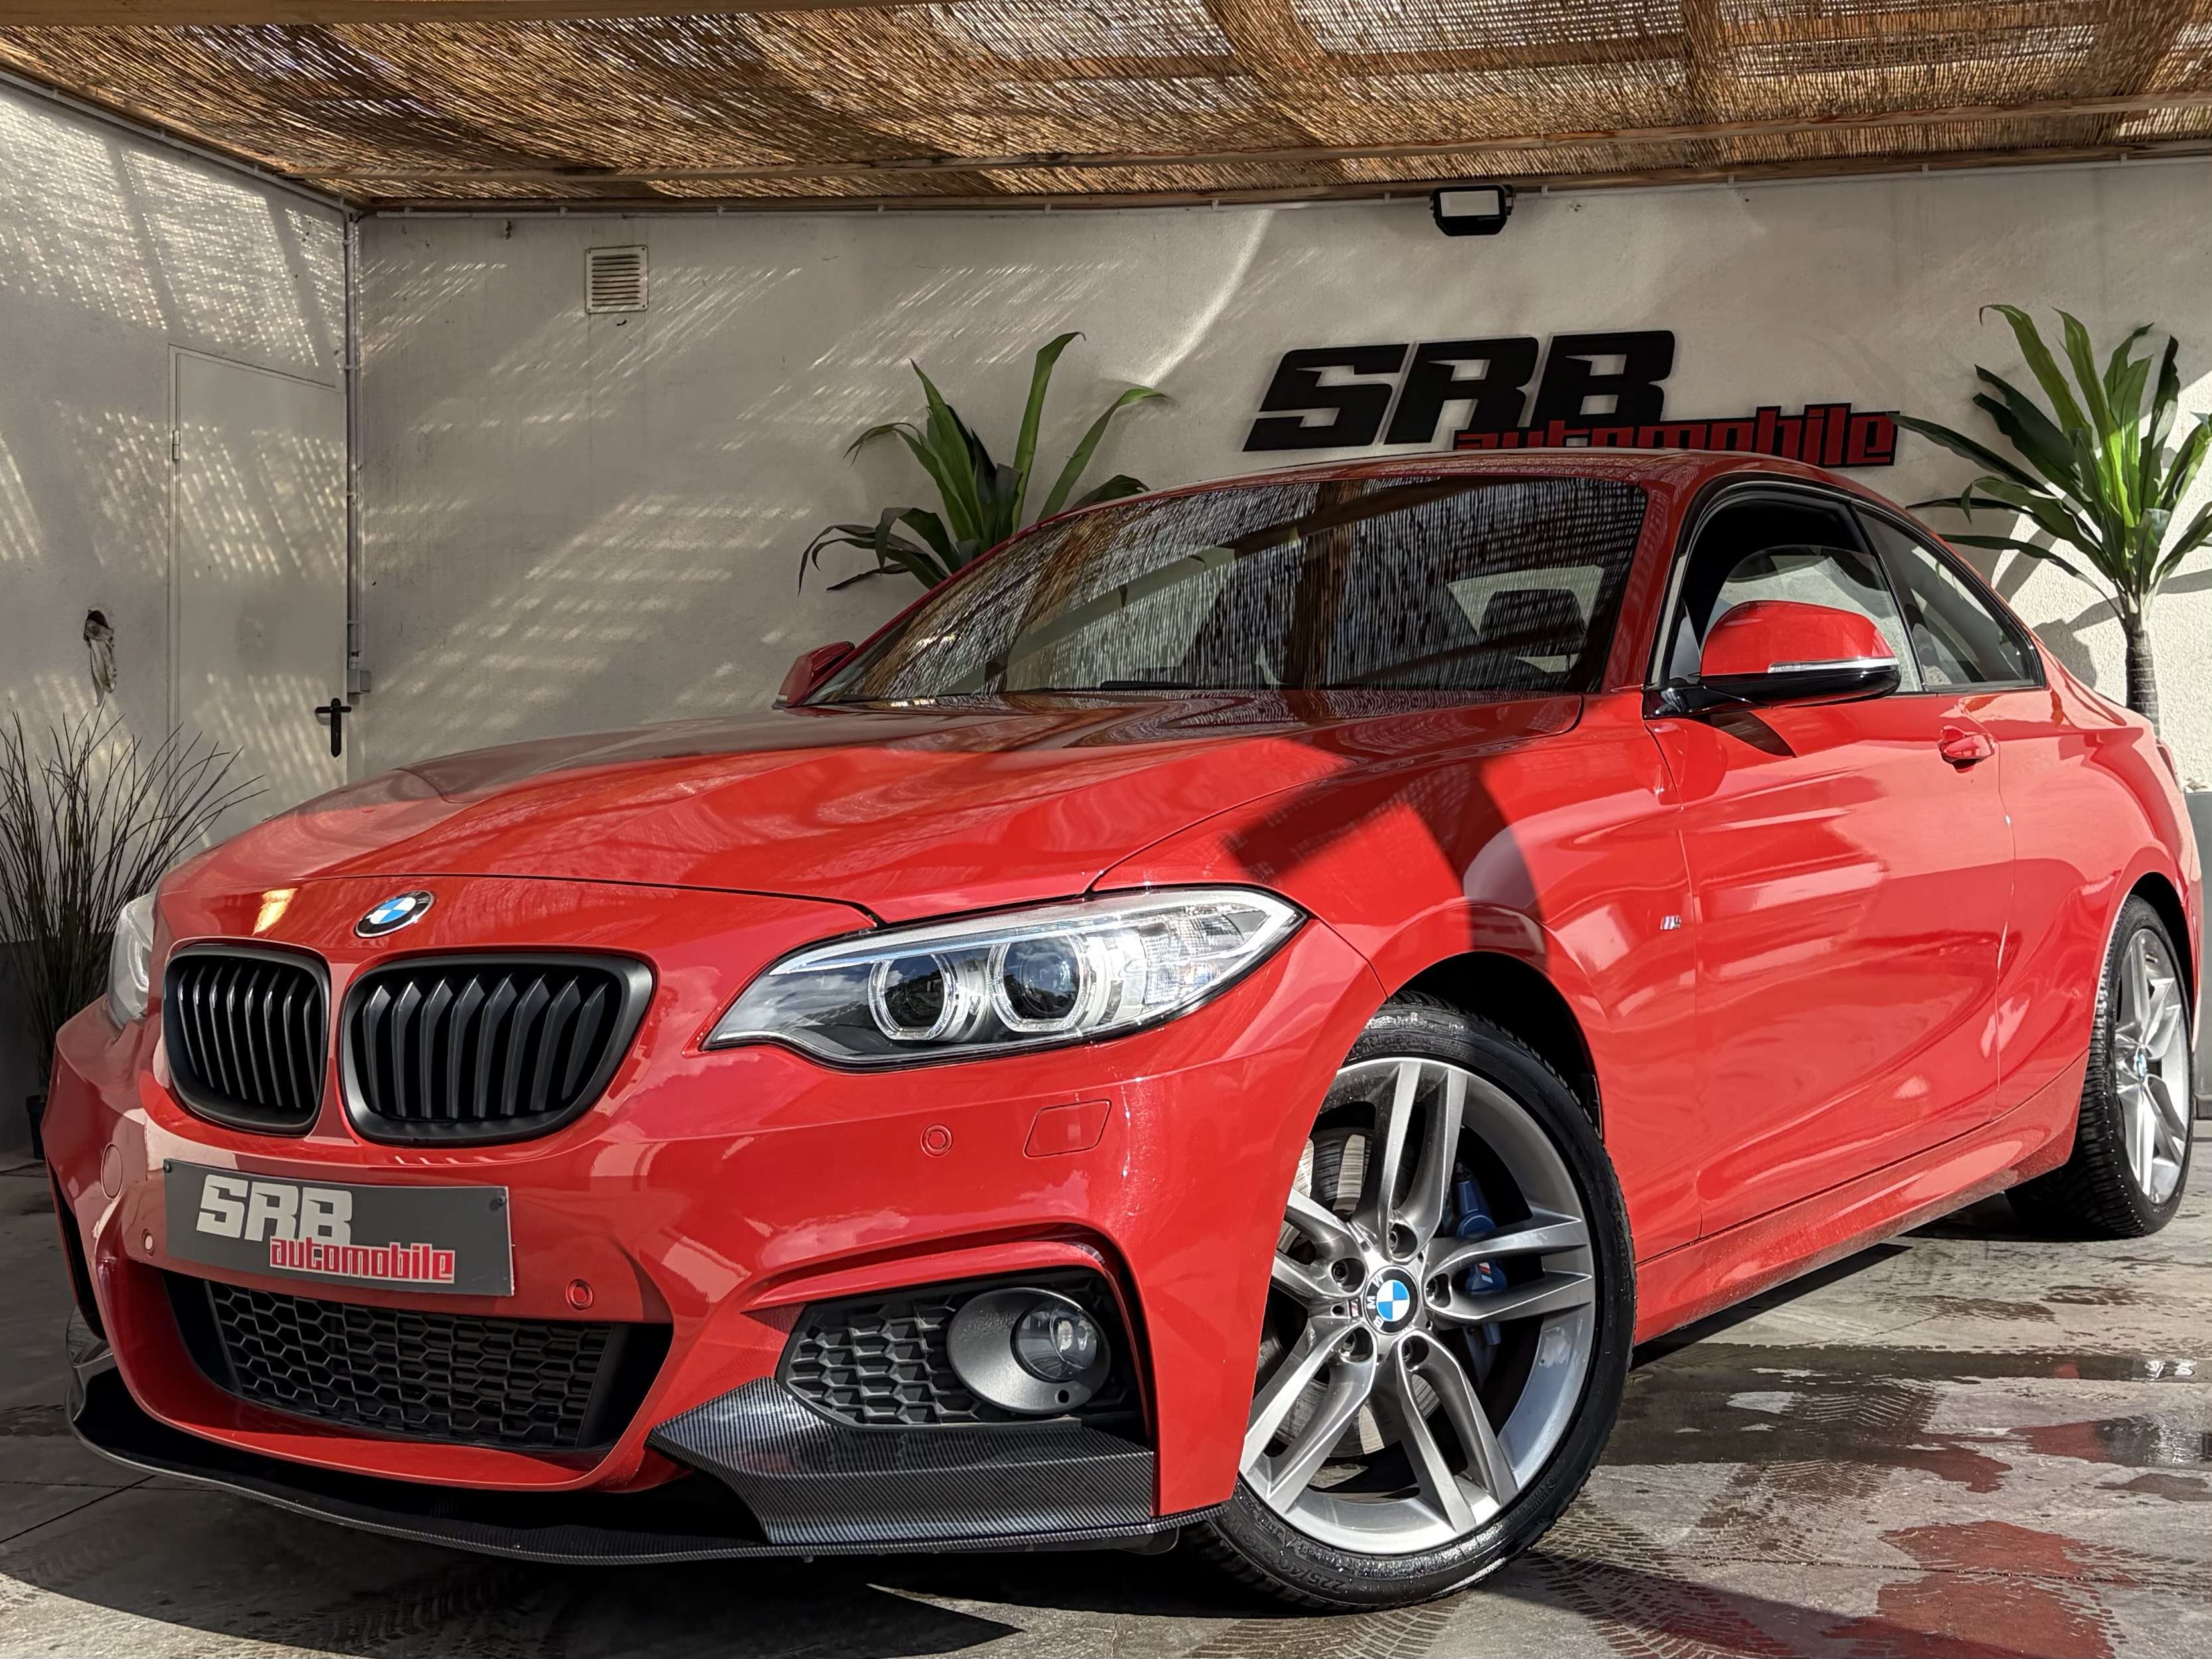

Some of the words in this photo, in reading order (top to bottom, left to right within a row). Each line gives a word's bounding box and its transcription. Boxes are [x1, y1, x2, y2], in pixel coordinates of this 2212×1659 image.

[1242, 330, 1675, 452] SRB
[196, 1174, 353, 1245] SRB
[270, 1236, 455, 1283] automobile
